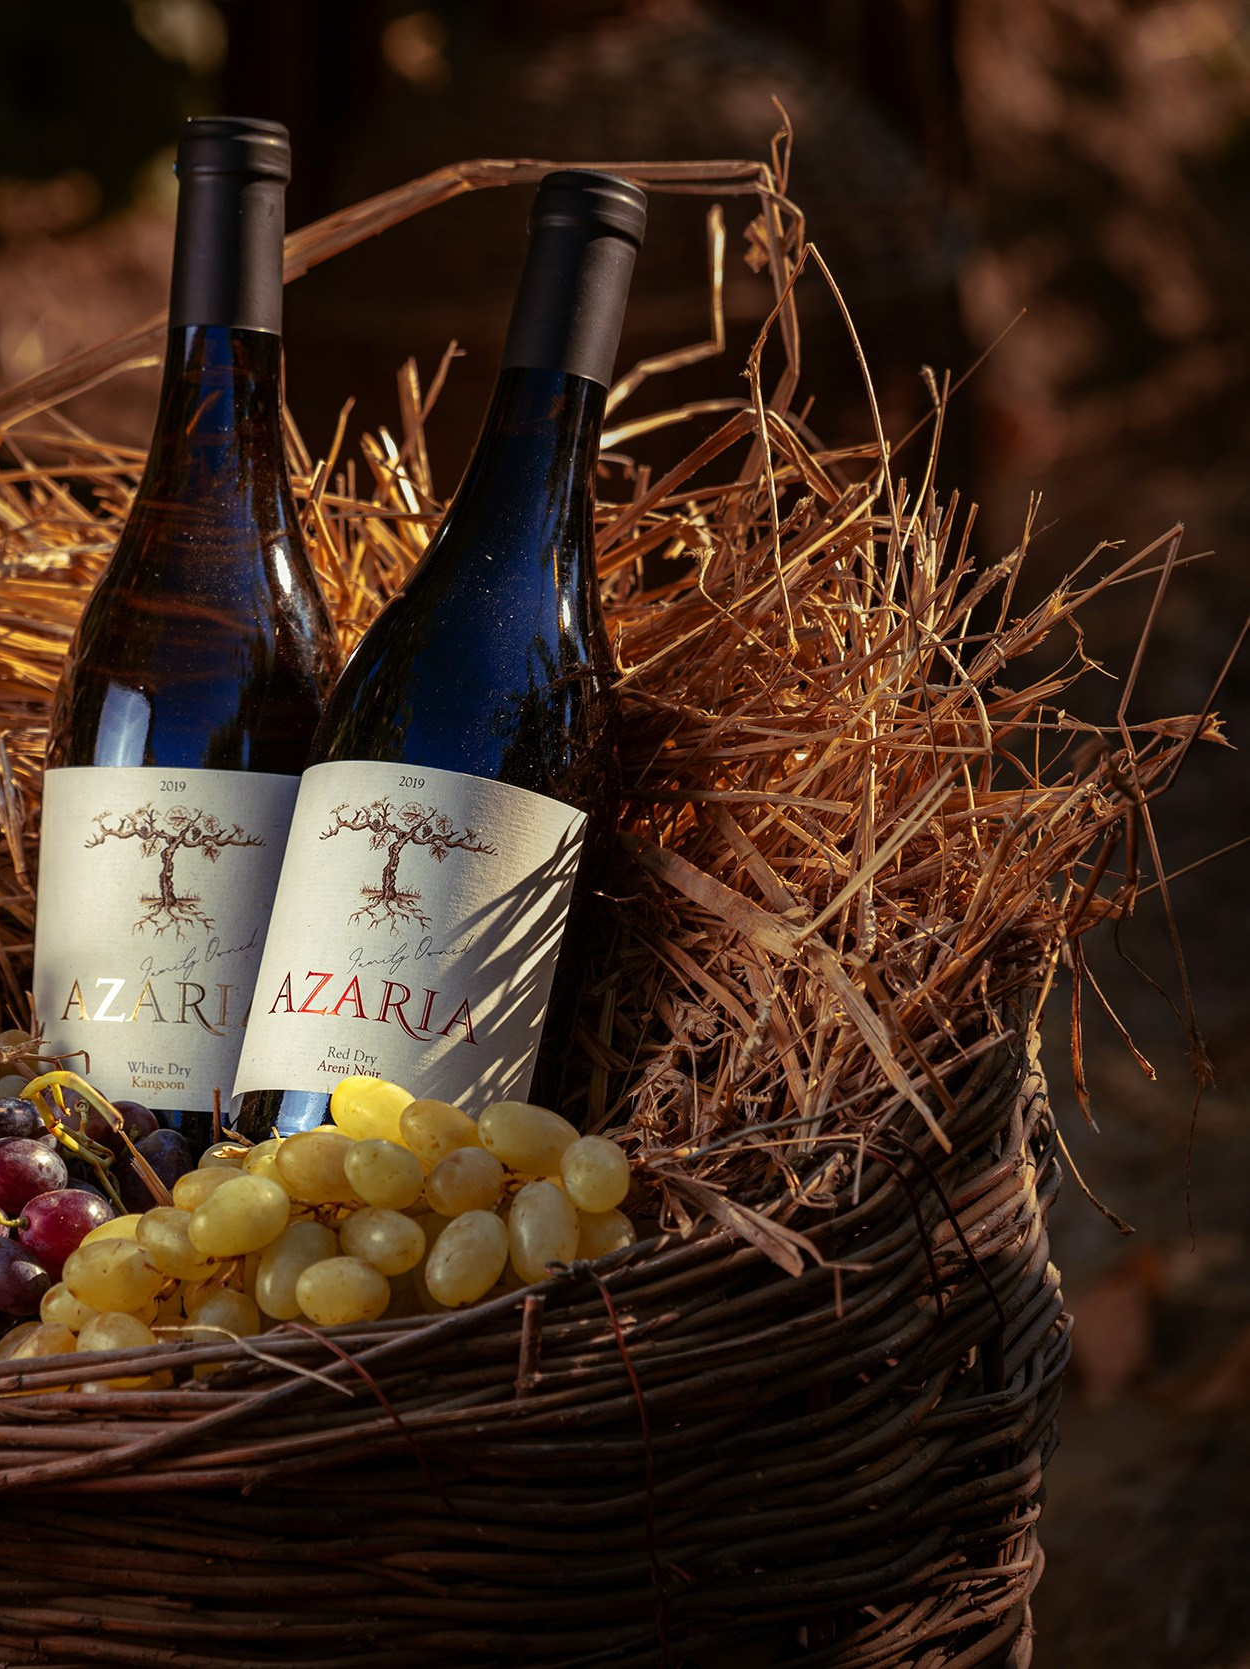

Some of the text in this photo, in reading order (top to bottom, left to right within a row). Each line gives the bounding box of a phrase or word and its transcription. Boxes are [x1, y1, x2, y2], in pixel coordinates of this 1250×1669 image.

[160, 780, 186, 792] 2019
[399, 776, 425, 790] 2019
[268, 970, 478, 1045] AZARIA
[327, 1046, 377, 1066] Red Dry
[128, 1061, 192, 1079] White Dry
[317, 1060, 381, 1078] Areni Noir
[131, 1076, 185, 1091] Kangoon
